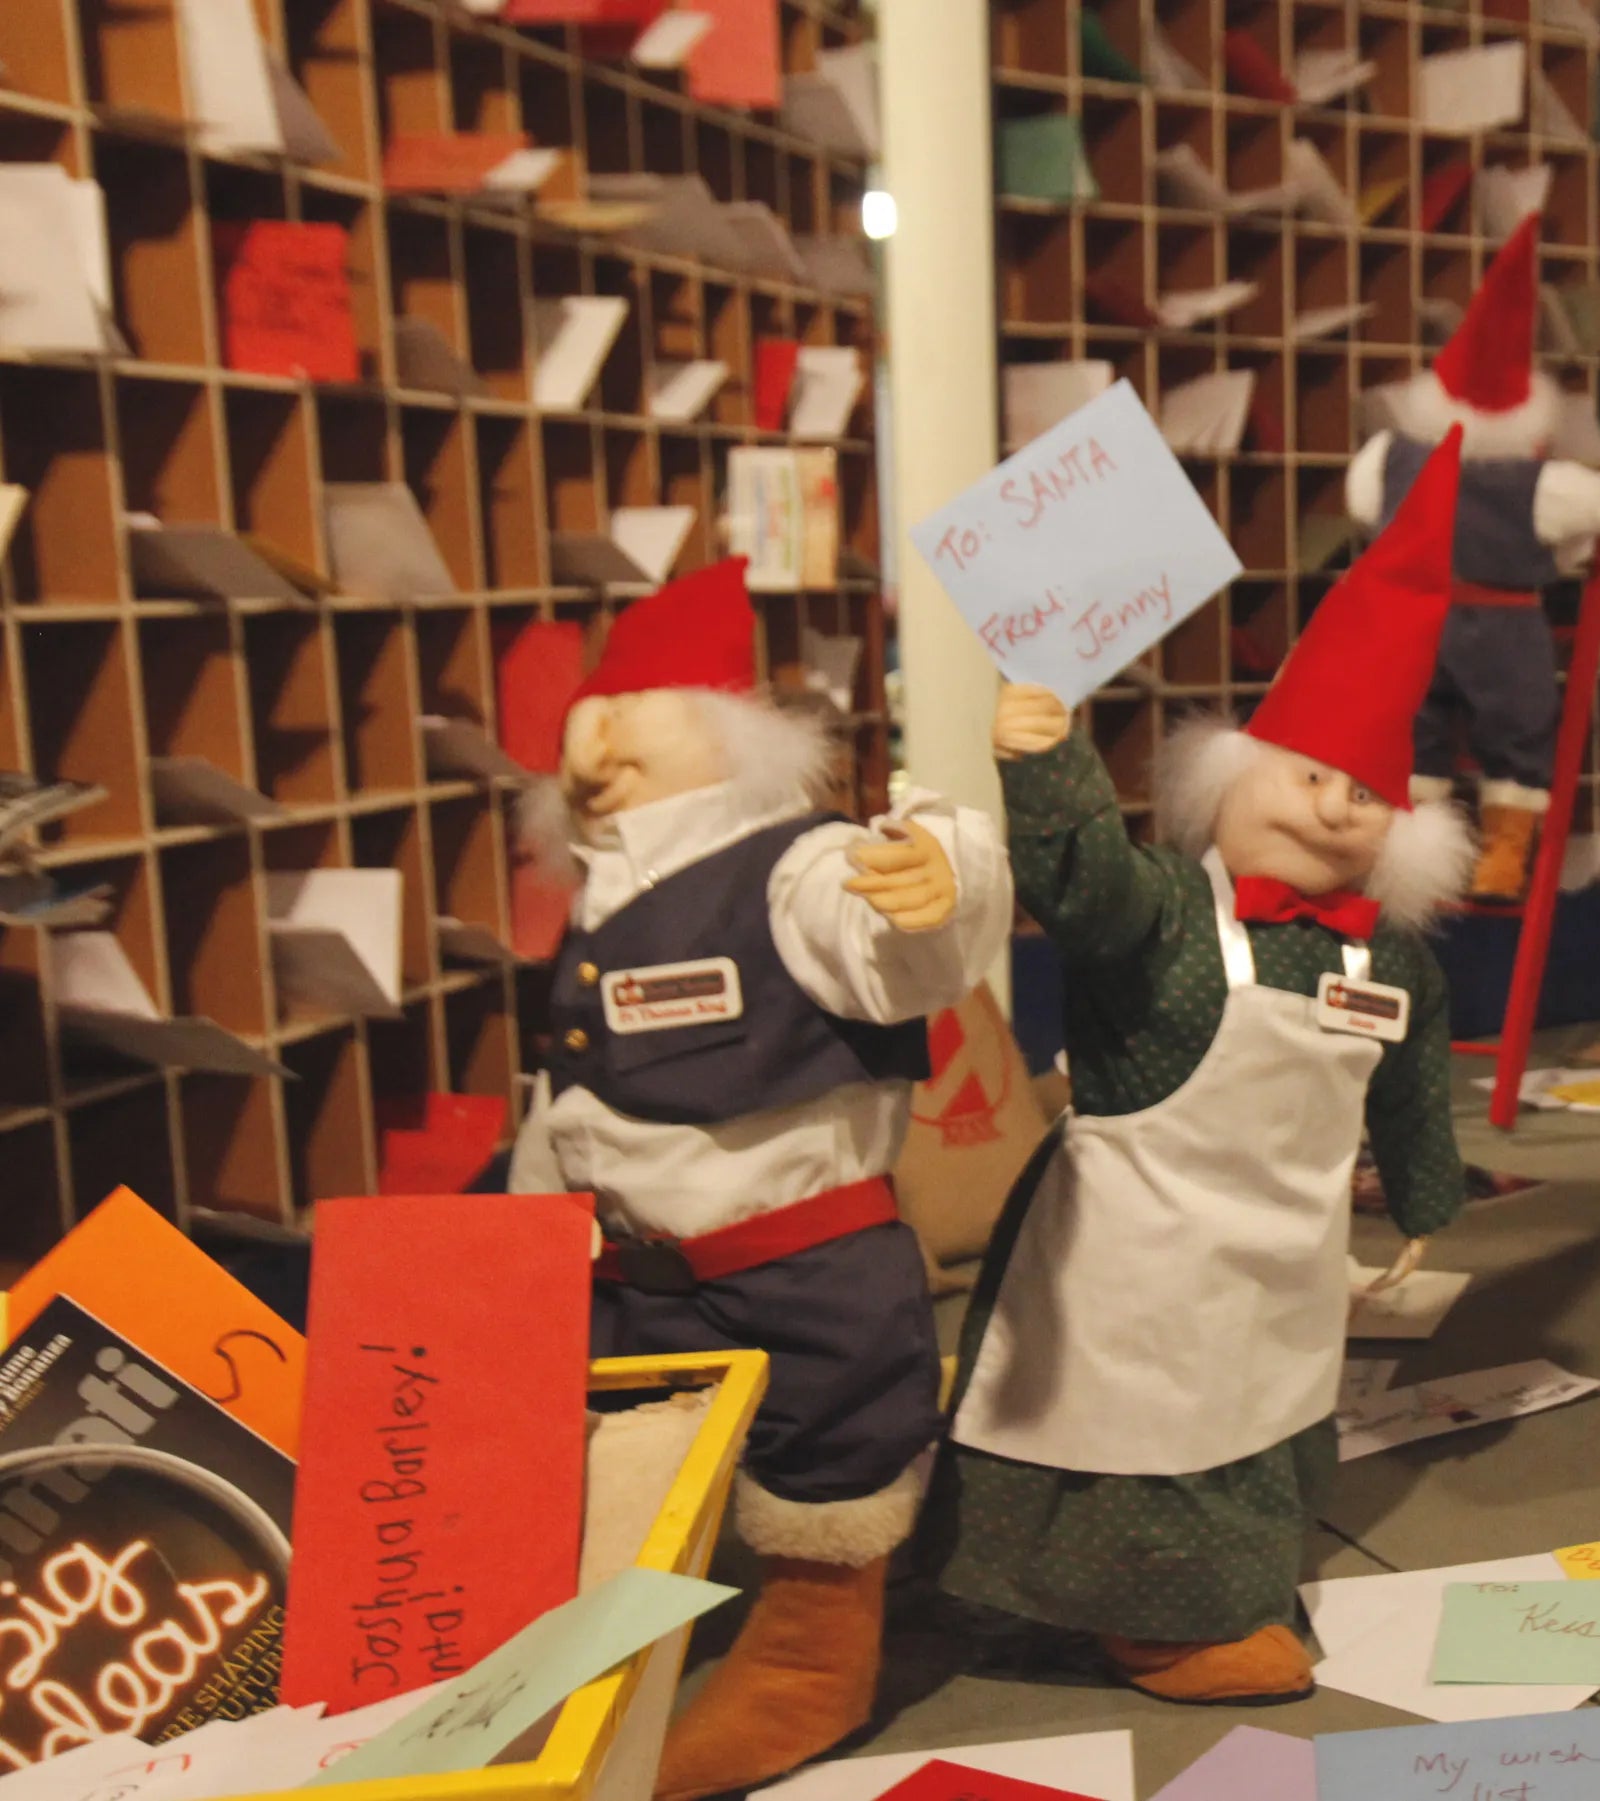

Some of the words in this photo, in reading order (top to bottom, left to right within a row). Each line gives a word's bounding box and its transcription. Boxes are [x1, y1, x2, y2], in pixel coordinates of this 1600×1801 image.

[1000, 437, 1119, 529] SANTA
[1069, 572, 1175, 661] Jenny
[351, 1517, 423, 1688] Joshua
[408, 1585, 465, 1684] nta!
[212, 1642, 284, 1723] UTUR
[1413, 1751, 1470, 1793] My
